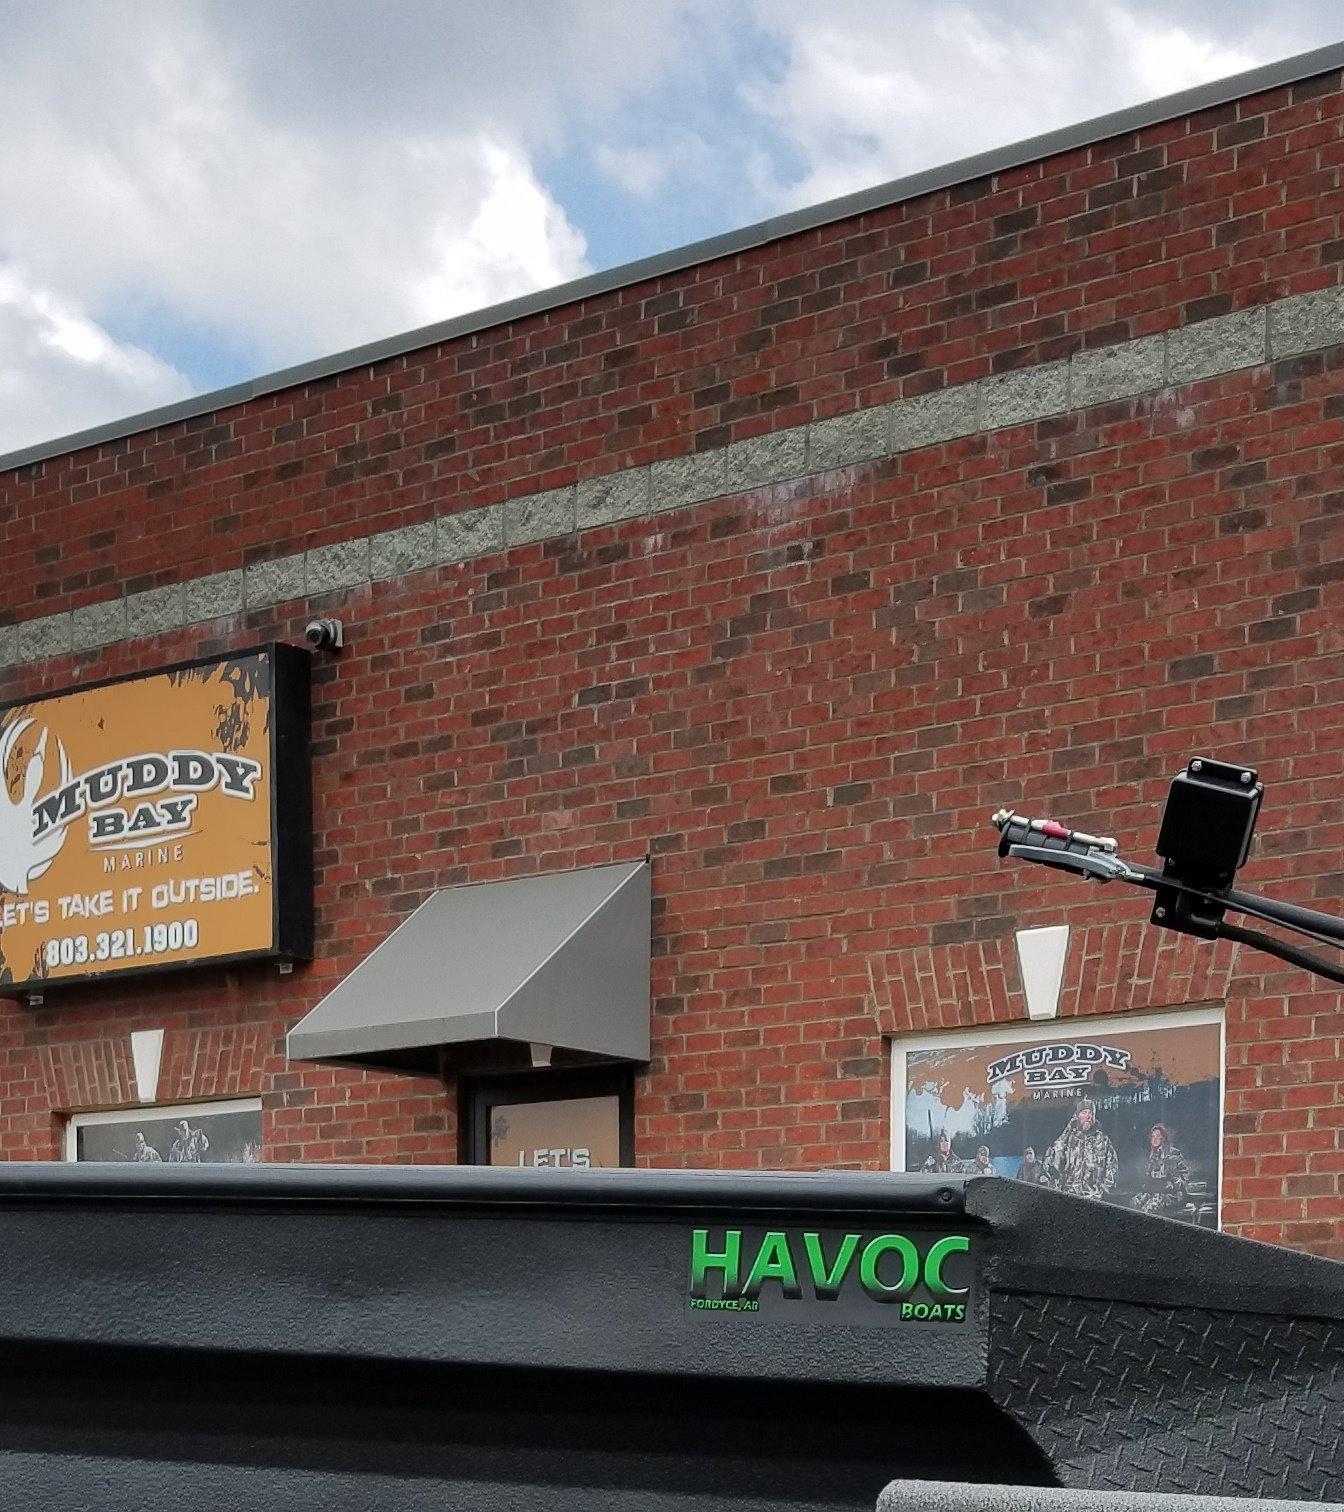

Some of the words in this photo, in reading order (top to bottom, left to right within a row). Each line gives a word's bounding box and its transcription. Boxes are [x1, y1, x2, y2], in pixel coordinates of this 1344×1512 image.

[31, 751, 261, 841] MUDDY
[92, 797, 194, 840] BAY
[103, 844, 185, 874] MARINE
[58, 892, 114, 920] TAKE
[122, 887, 143, 911] IT
[151, 869, 261, 910] OUTSIDE.
[45, 918, 199, 968] 803.321.1900
[987, 1044, 1131, 1083] MUDDY
[1025, 1065, 1093, 1083] BAY
[1032, 1088, 1083, 1100] MARINE
[690, 1229, 971, 1304] HAVOC
[900, 1303, 965, 1321] BOATS
